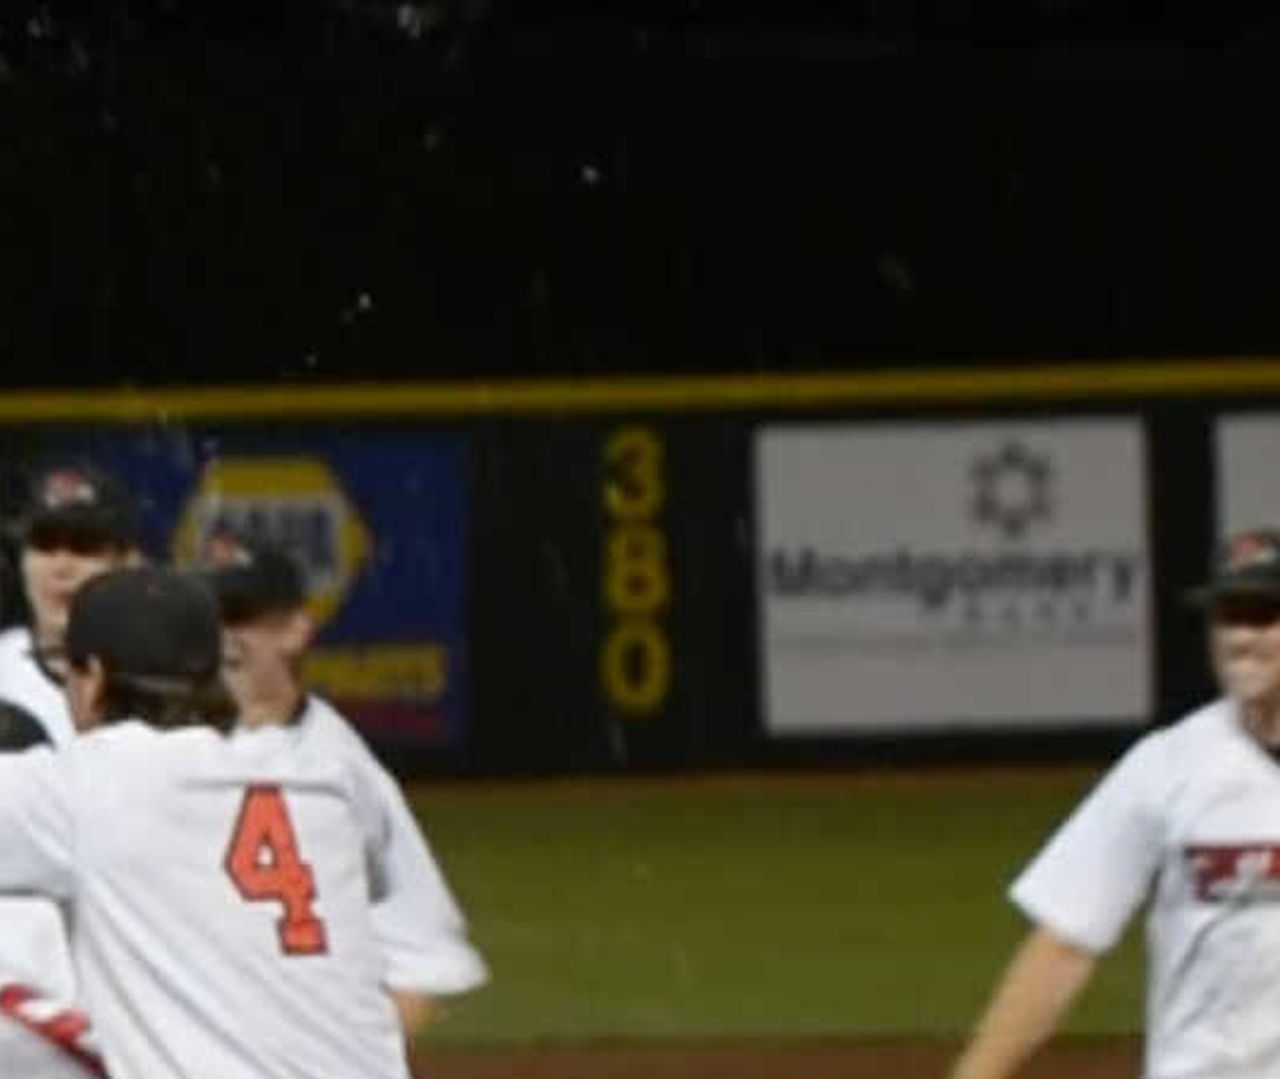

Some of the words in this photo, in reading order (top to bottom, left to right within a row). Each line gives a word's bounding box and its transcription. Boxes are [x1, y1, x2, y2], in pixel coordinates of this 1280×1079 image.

[602, 426, 671, 712] 380
[770, 546, 1134, 608] Montgomery
[225, 782, 329, 956] 4
